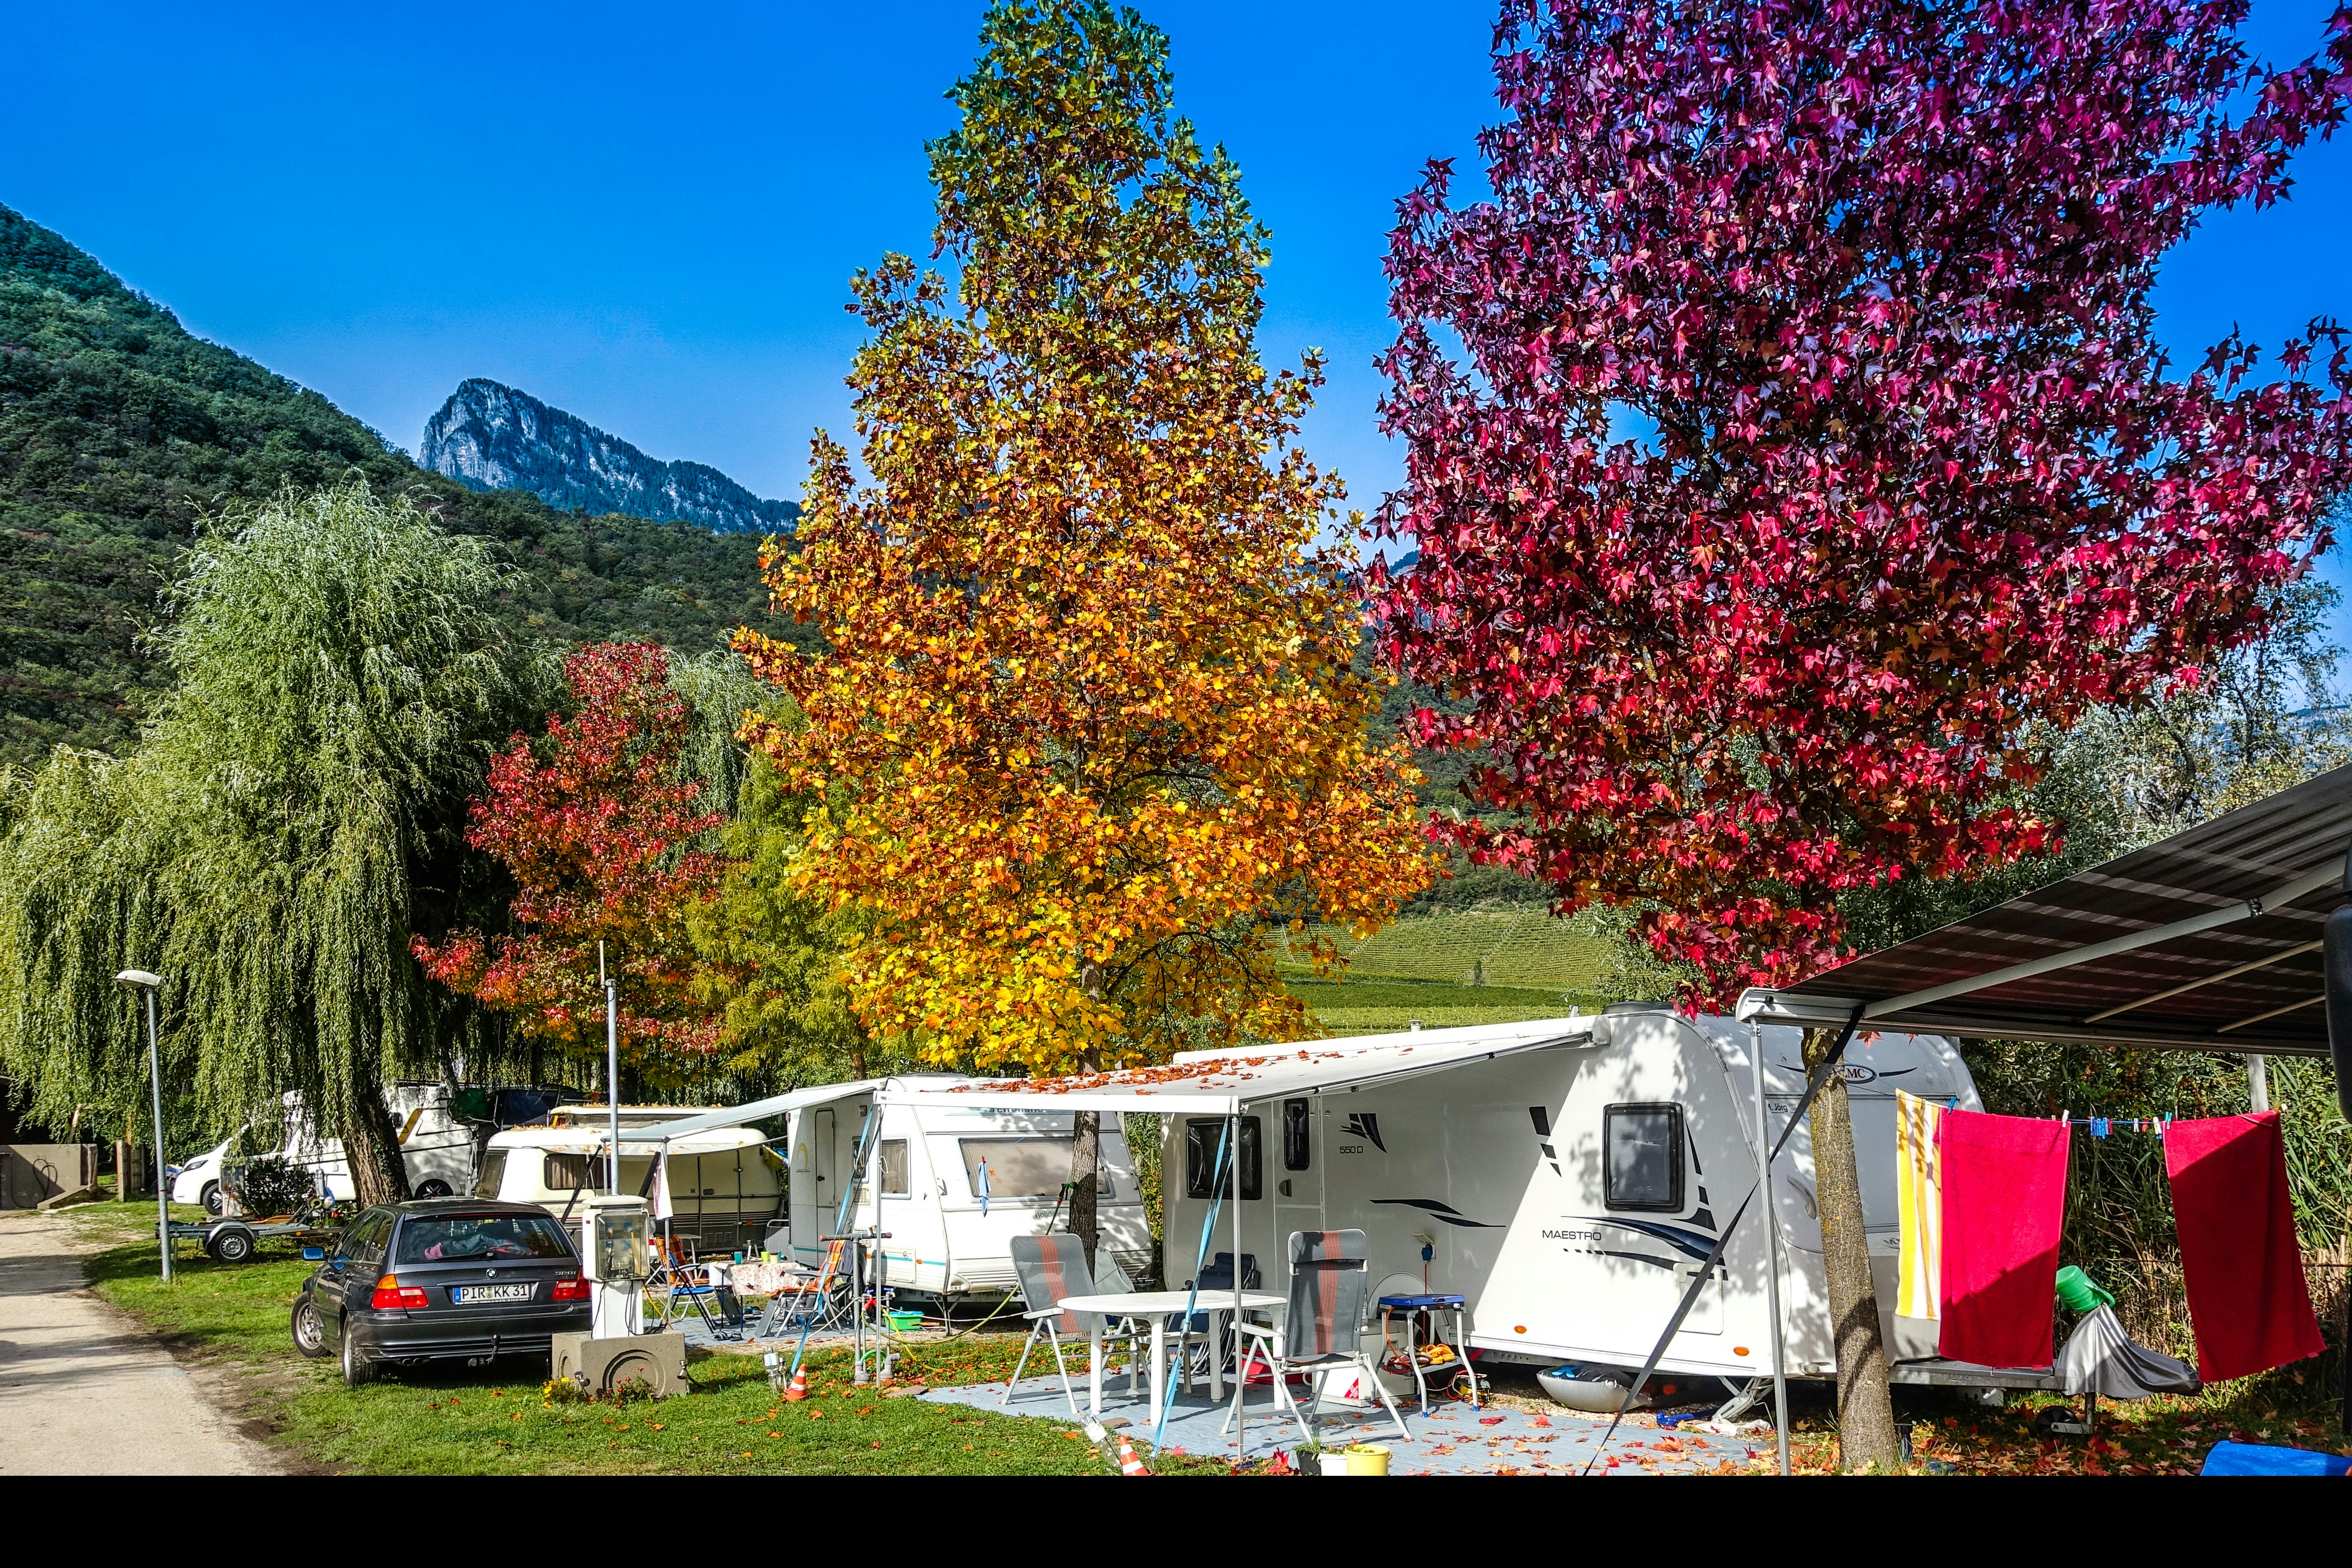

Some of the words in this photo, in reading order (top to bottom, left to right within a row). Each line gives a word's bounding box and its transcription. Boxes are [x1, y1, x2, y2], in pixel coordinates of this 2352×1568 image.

[1845, 1068, 1866, 1078] MC
[1542, 1230, 1601, 1241] MAESTRO
[462, 1287, 485, 1299] PIR
[494, 1286, 510, 1298] KK
[513, 1285, 527, 1296] 31
